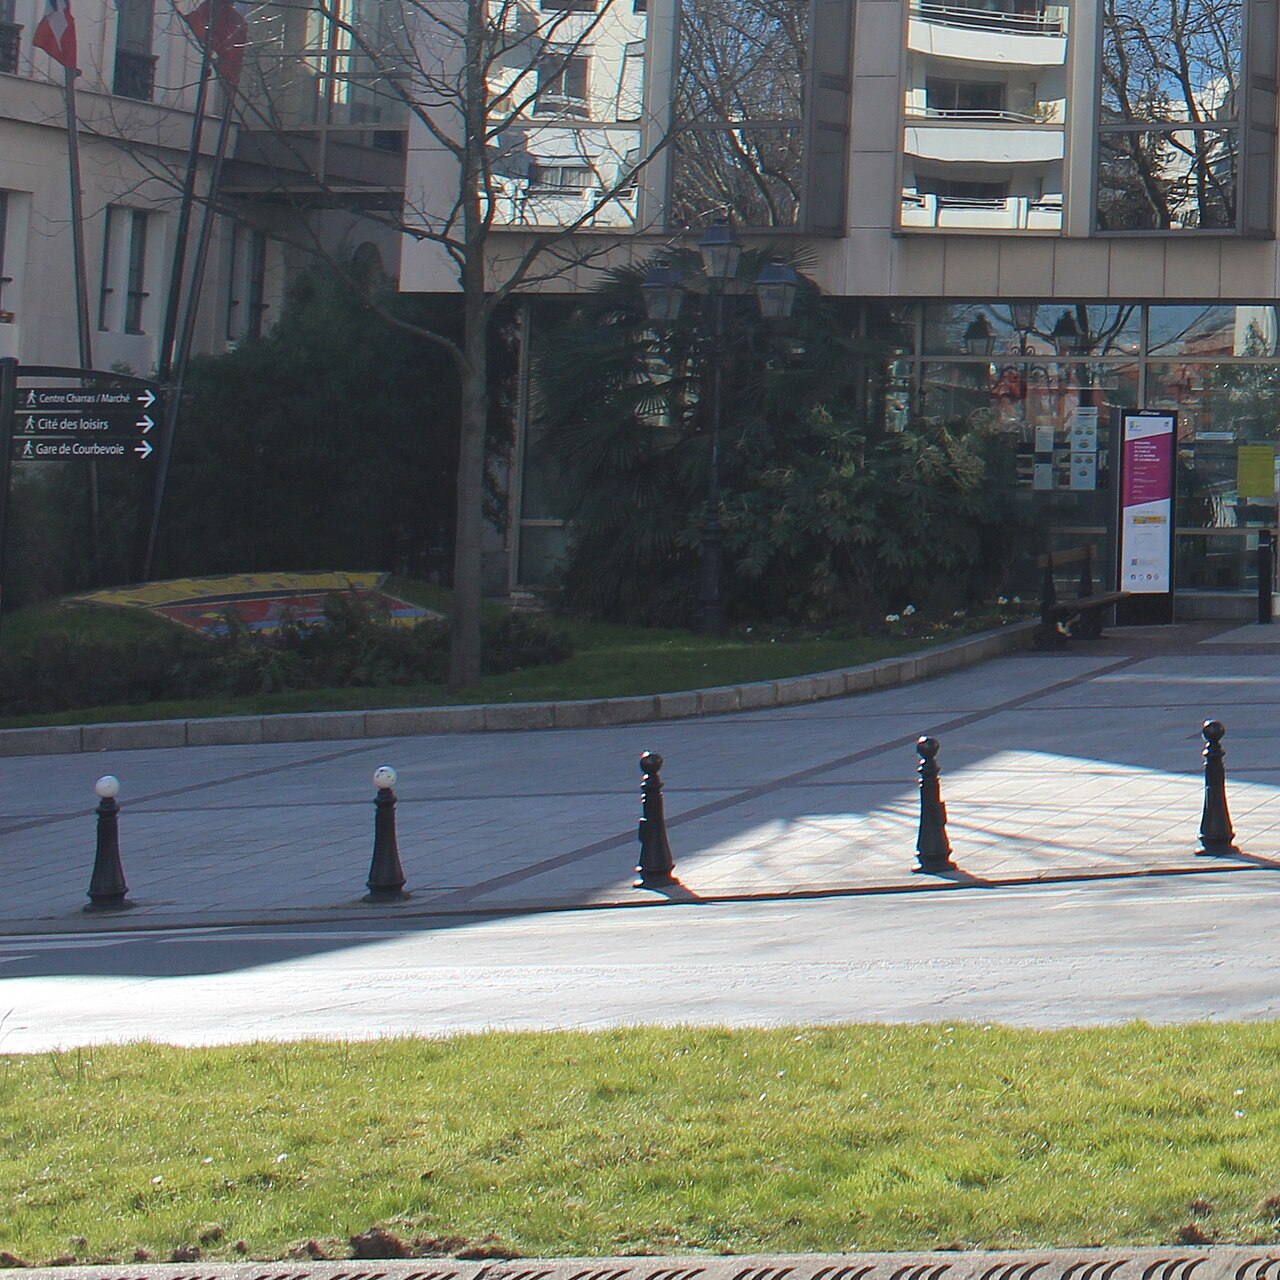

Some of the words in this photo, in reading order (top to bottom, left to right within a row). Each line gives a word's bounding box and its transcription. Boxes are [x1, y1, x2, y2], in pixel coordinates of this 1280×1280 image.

[39, 393, 65, 403] Centre
[66, 393, 95, 403] Charras
[101, 393, 130, 403] Marché
[37, 418, 58, 430] Cité
[60, 418, 78, 430] des
[80, 418, 109, 430] loisirs
[35, 443, 57, 455] Gare
[58, 443, 71, 455] de
[72, 443, 125, 455] Courbevoie
